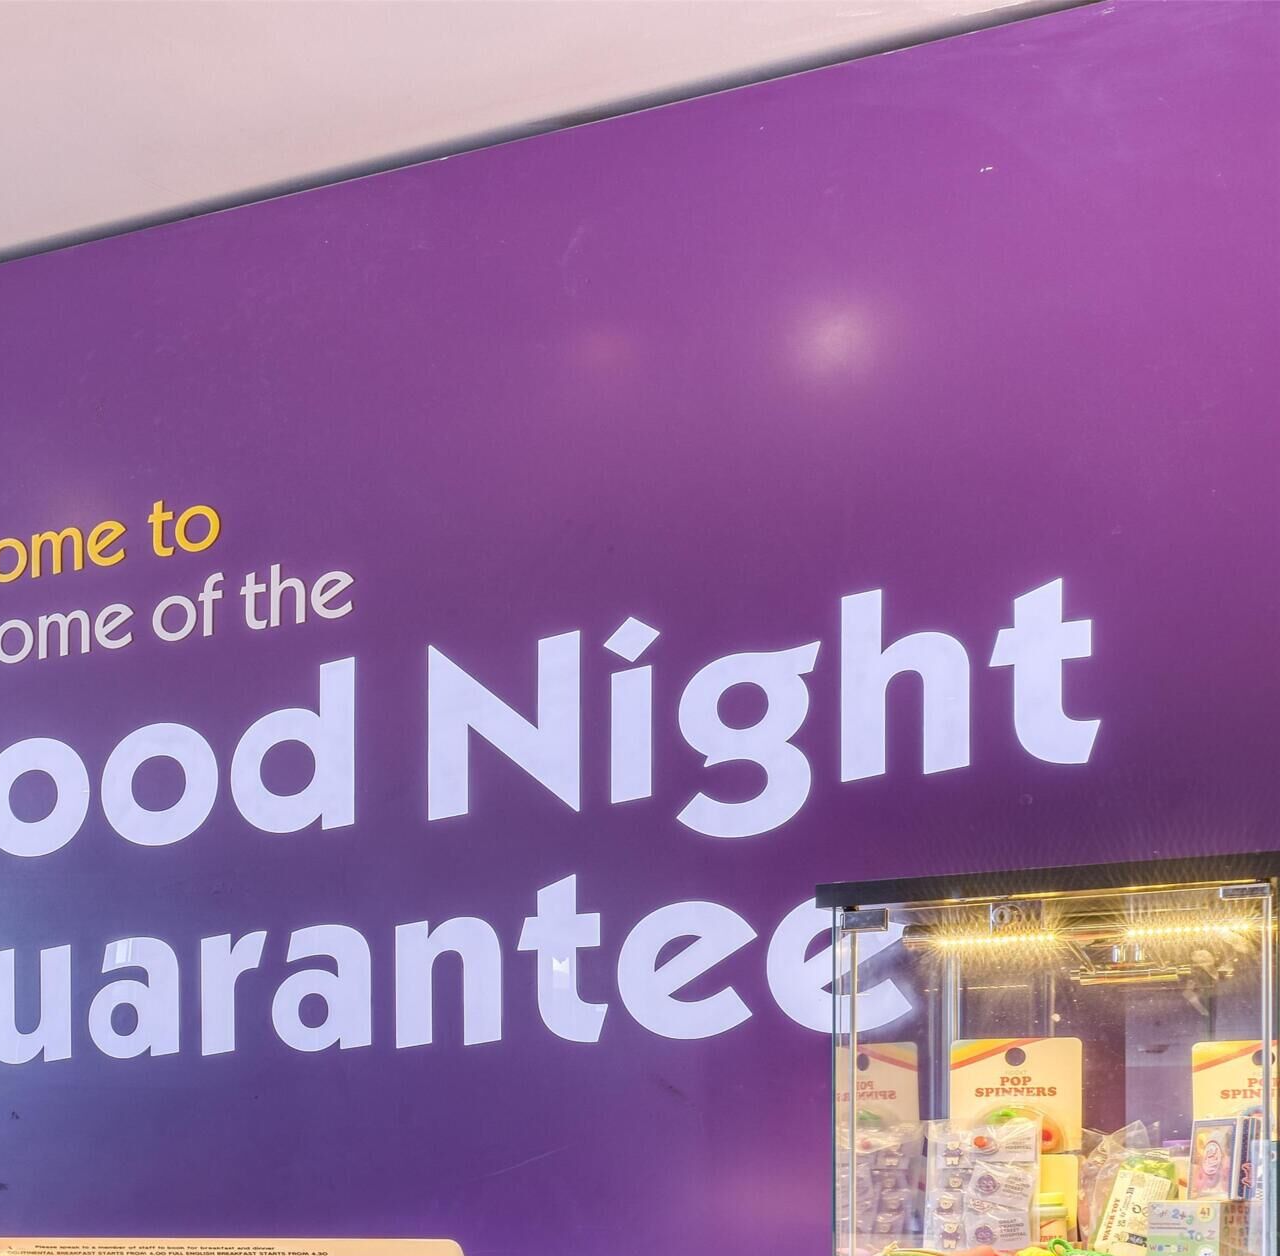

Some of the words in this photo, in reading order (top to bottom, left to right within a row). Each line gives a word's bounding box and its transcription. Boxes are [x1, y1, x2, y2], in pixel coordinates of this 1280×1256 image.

[148, 499, 221, 556] to
[151, 571, 228, 647] of
[240, 562, 357, 631] the
[427, 577, 1102, 839] Night
[975, 1087, 1057, 1098] SPINNERS
[1000, 1076, 1032, 1086] POP
